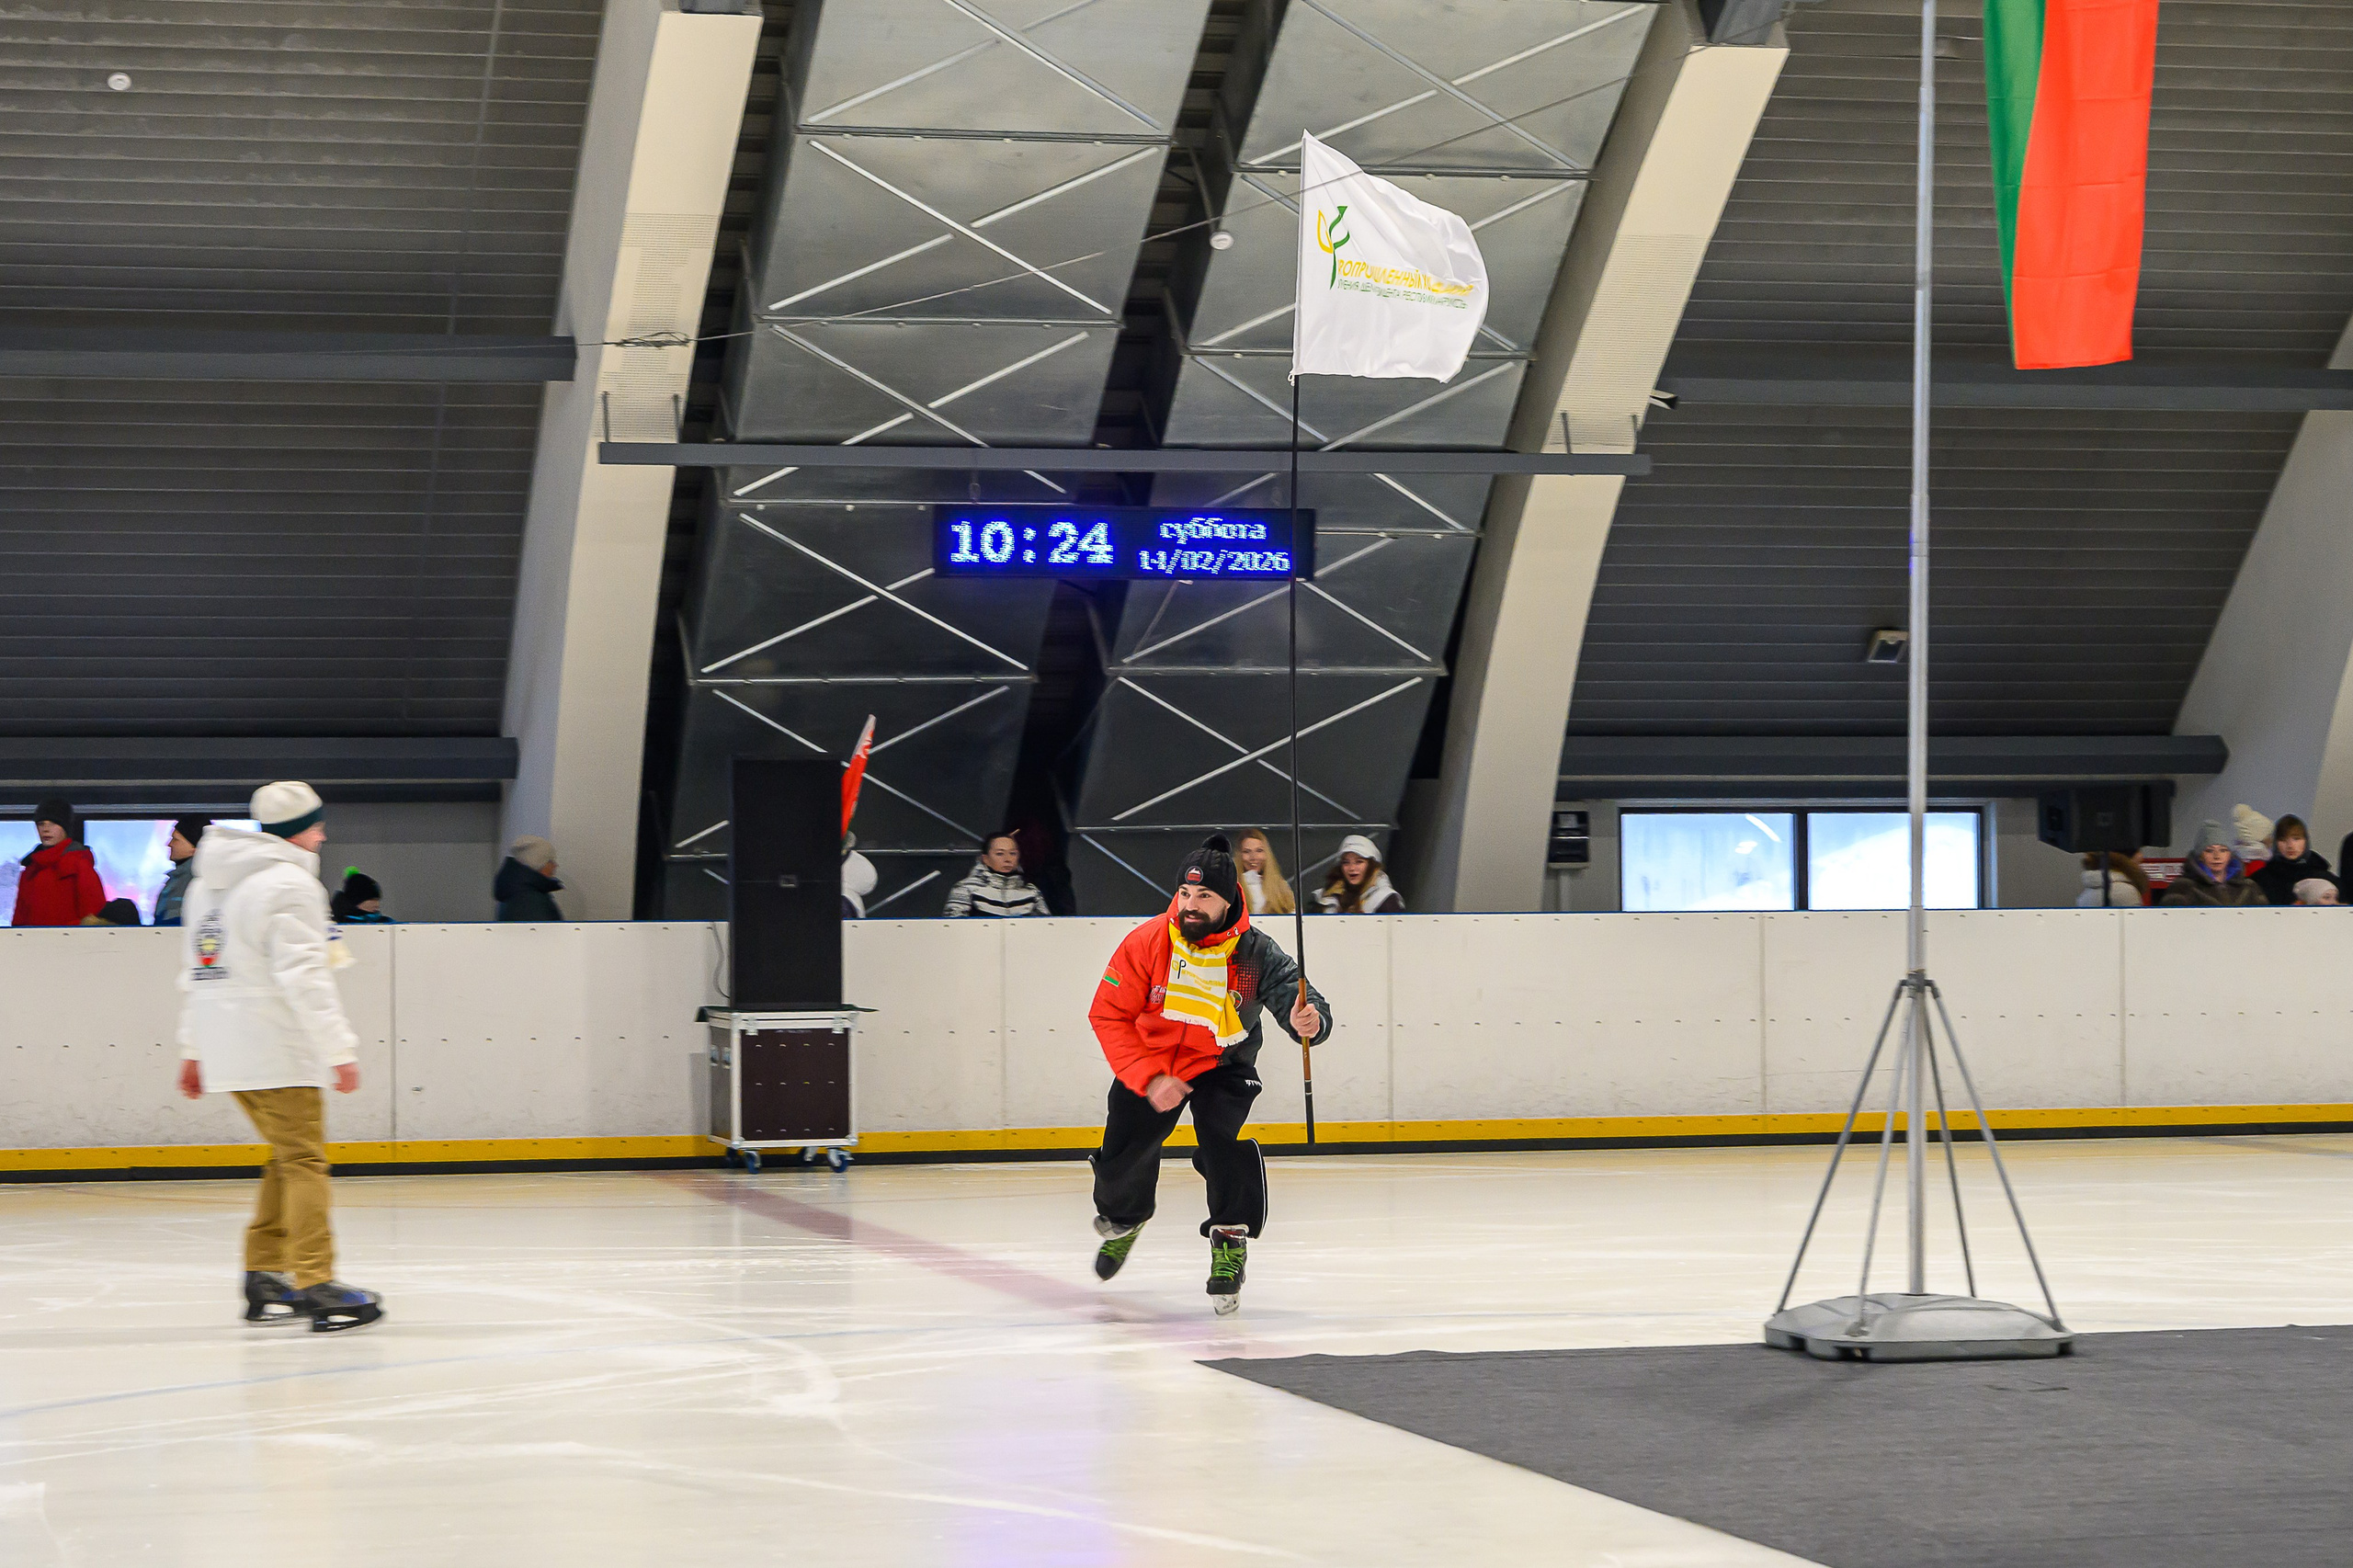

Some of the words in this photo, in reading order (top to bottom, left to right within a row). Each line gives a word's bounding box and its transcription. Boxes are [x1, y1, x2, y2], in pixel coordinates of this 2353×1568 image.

[950, 521, 1114, 563] 10:24
[1160, 517, 1267, 544] суббота
[1139, 550, 1290, 574] 14/02/2026
